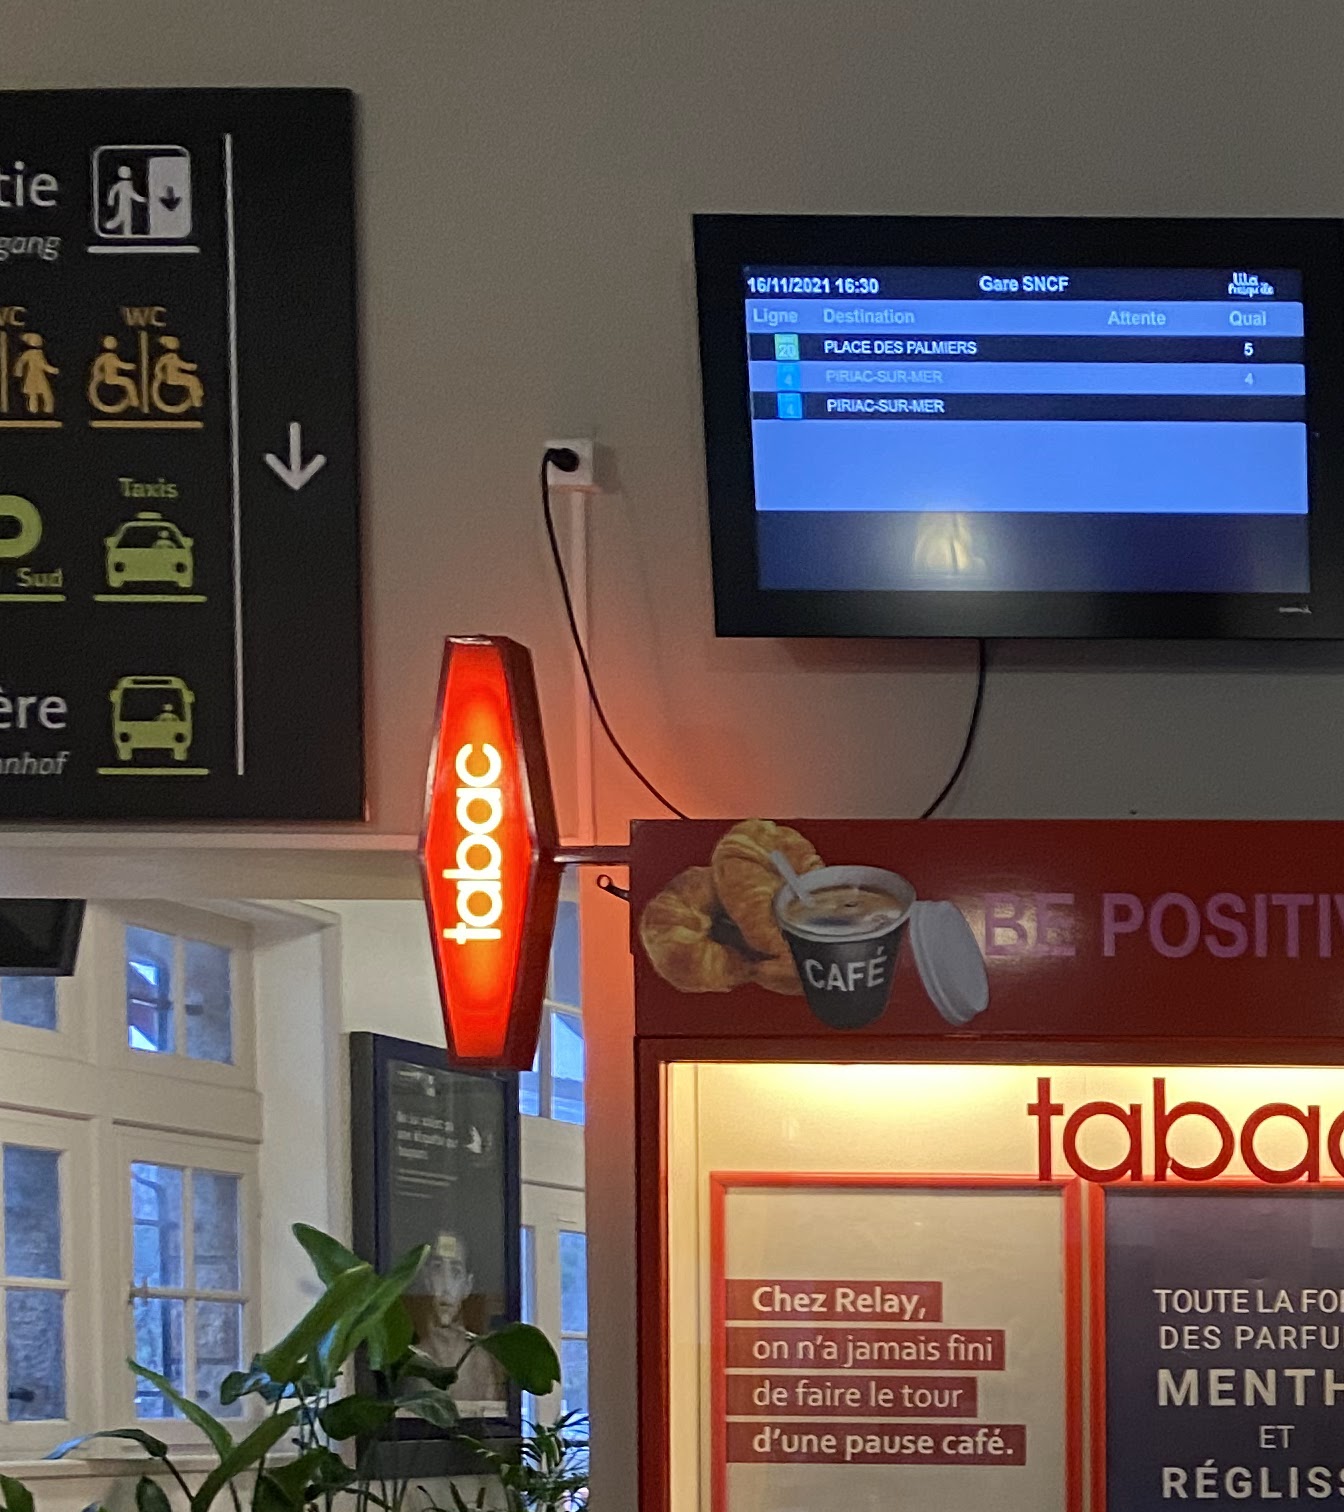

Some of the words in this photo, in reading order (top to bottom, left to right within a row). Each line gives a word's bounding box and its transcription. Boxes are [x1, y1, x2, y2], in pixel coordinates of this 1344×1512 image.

[747, 277, 831, 294] 16/11/2021
[835, 277, 879, 294] 16:30
[978, 275, 1018, 293] Gare
[1022, 274, 1069, 293] SNCF
[122, 306, 168, 327] WC
[753, 308, 798, 326] Ligne
[823, 308, 915, 325] Destination
[1107, 310, 1167, 327] Attente
[1229, 310, 1267, 327] Quai
[824, 340, 871, 354] PLACE
[877, 341, 903, 354] DES
[906, 341, 977, 355] PALMIERS
[1243, 342, 1254, 357] 5
[825, 370, 943, 384] PIRIAC-SUR-MER
[1244, 372, 1254, 386] 4
[827, 398, 944, 414] PIRIAC-SUR-MER
[118, 477, 179, 498] Taxis
[16, 567, 64, 588] Sud
[443, 743, 502, 945] tabac
[984, 892, 1076, 957] BE
[802, 946, 888, 993] CAFÉ
[752, 1286, 827, 1313] Chez
[835, 1287, 926, 1320] Relay,
[1152, 1289, 1250, 1314] TOUTE
[1256, 1289, 1294, 1314] LA
[1158, 1325, 1222, 1350] DES
[752, 1338, 789, 1360] on
[796, 1335, 838, 1361] n'a
[844, 1336, 940, 1368] jamais
[947, 1336, 993, 1362] fini
[752, 1379, 788, 1406] de
[795, 1379, 862, 1407] faire
[869, 1380, 894, 1408] le
[902, 1384, 963, 1408] tour
[752, 1426, 837, 1454] d'une
[844, 1434, 934, 1461] pause
[942, 1428, 1014, 1456] café.
[1258, 1425, 1295, 1449] ET
